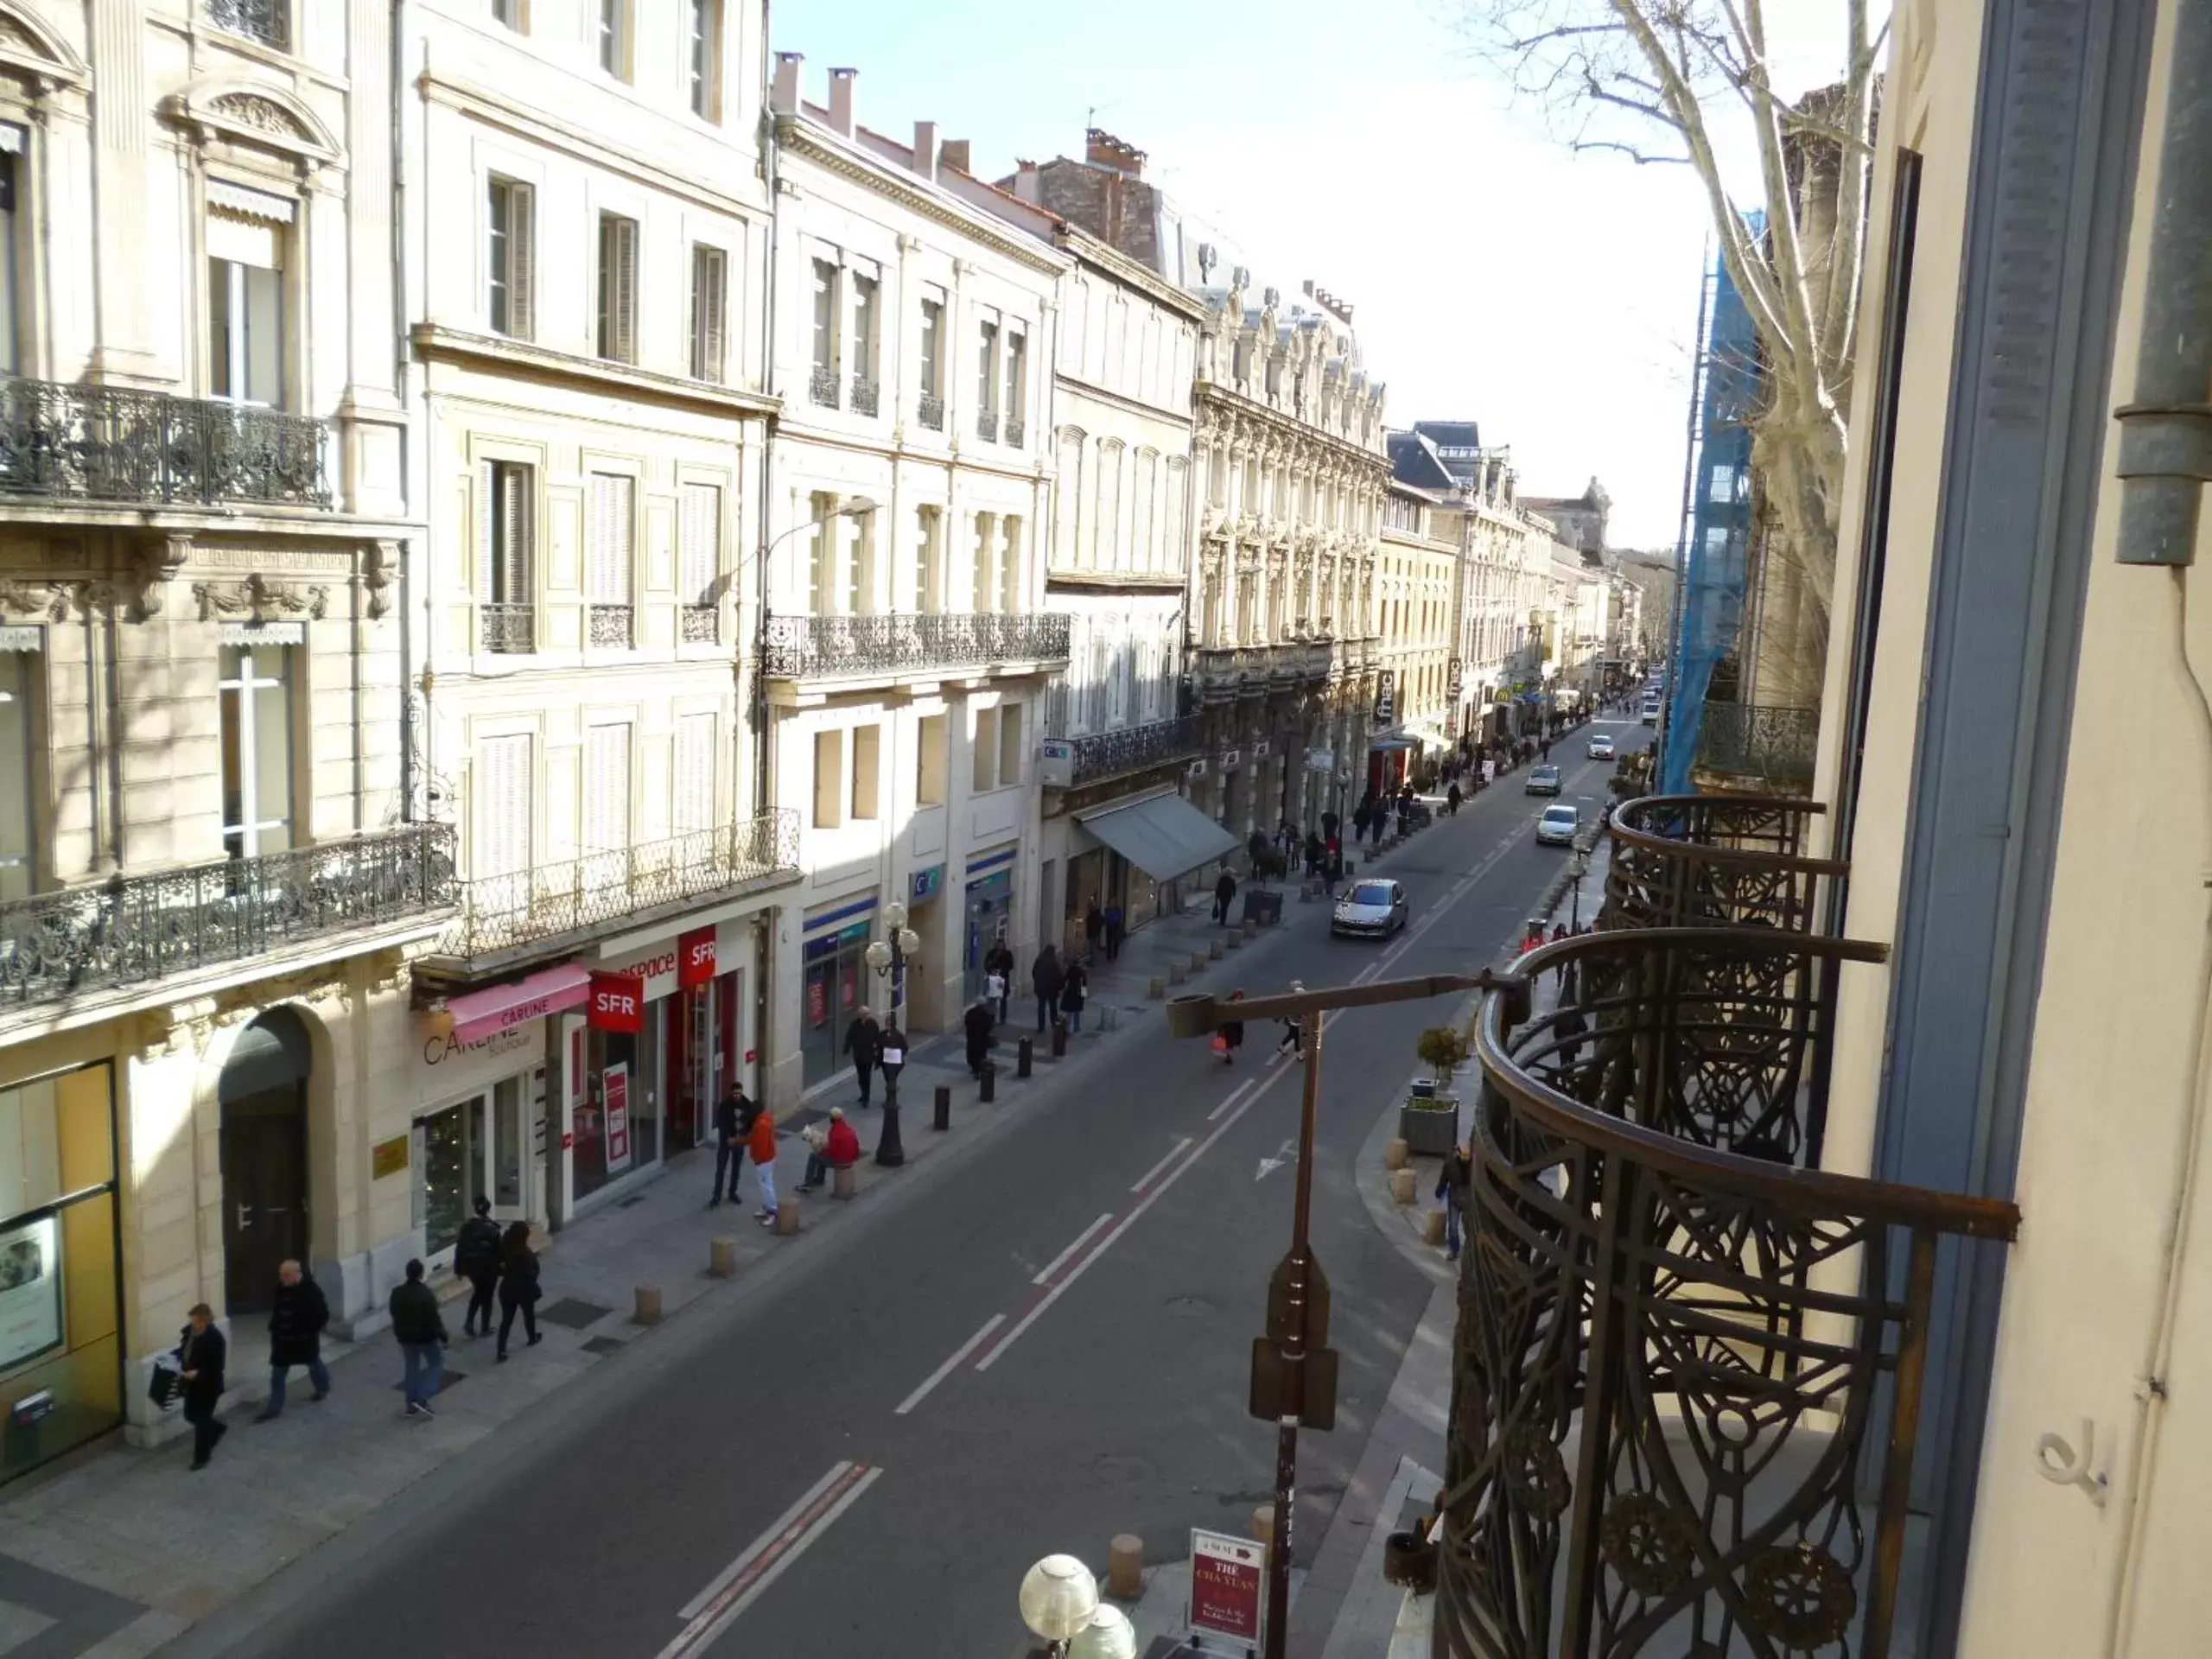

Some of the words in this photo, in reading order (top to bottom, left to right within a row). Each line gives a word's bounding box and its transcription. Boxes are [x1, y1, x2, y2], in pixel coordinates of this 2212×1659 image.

[1446, 661, 1460, 696] fnac
[1376, 673, 1393, 717] fnac
[692, 941, 716, 967] SFR
[500, 999, 550, 1027] CARLINE
[596, 993, 635, 1016] SFR
